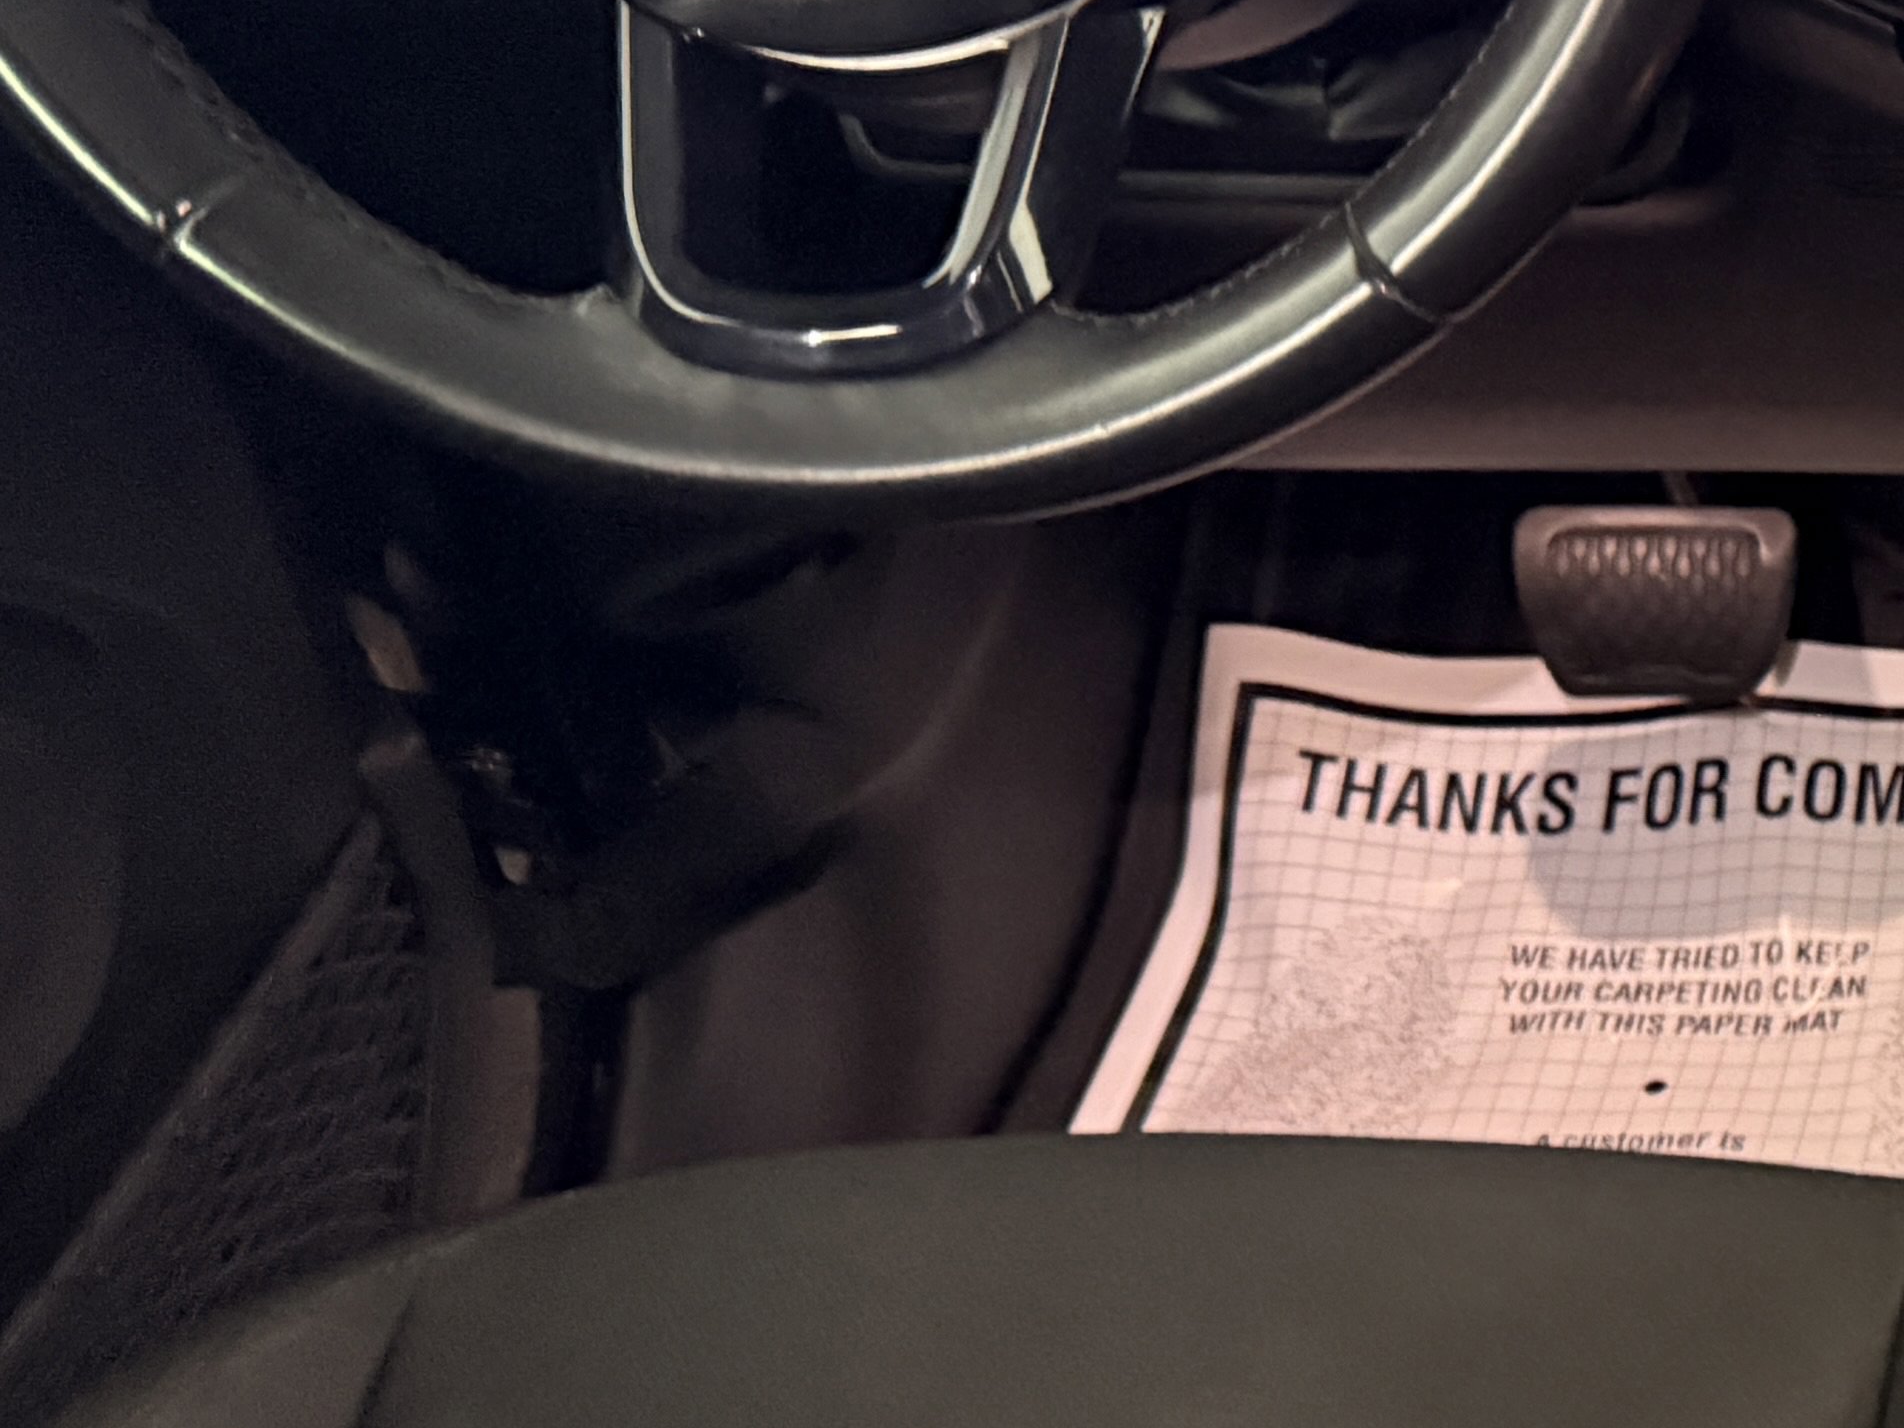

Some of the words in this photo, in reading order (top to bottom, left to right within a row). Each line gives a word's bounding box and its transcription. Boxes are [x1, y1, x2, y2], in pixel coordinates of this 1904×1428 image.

[1298, 748, 1579, 837] THANKS
[1602, 756, 1729, 836] FOR
[1509, 943, 1560, 970] WE
[1566, 946, 1646, 972] HAVE
[1655, 944, 1741, 972] TRIED
[1749, 940, 1786, 966] TO
[1499, 978, 1585, 1004] YOUR
[1592, 977, 1765, 1005] CARPETING
[1508, 1011, 1586, 1035] WITH
[1597, 1010, 1665, 1037] THIS
[1673, 1012, 1772, 1037] PAPER
[1782, 1008, 1846, 1036] MAT
[1563, 1130, 1714, 1154] customer
[1718, 1129, 1747, 1152] is
